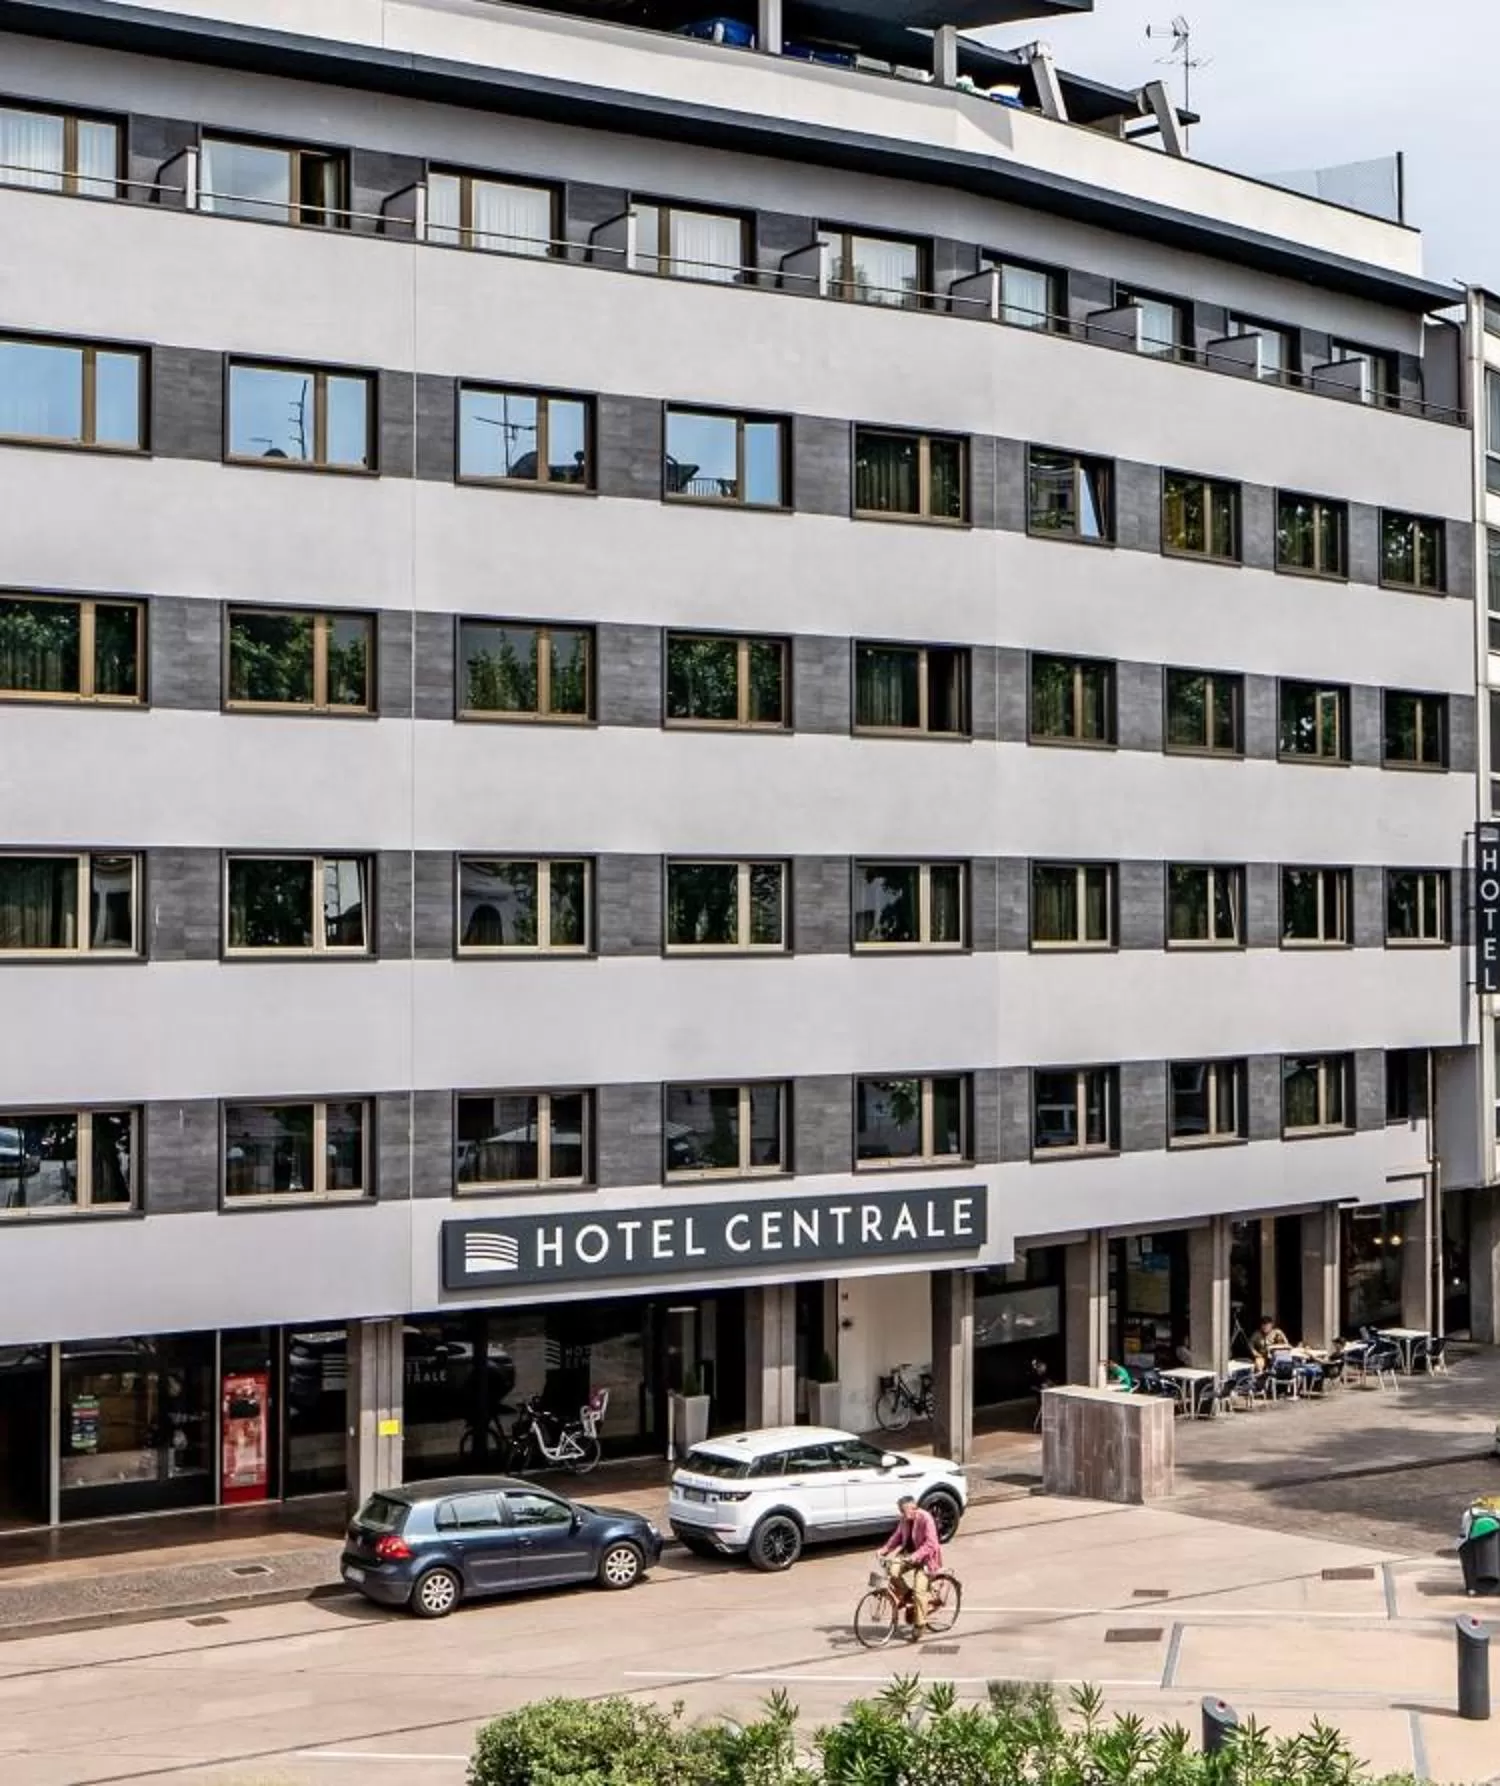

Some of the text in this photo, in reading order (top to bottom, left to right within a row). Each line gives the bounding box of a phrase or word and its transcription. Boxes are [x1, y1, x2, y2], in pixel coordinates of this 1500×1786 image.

[1480, 849, 1500, 991] HOTEL
[536, 1198, 973, 1268] HOTEL CENTRALE
[406, 1369, 448, 1384] TRALE
